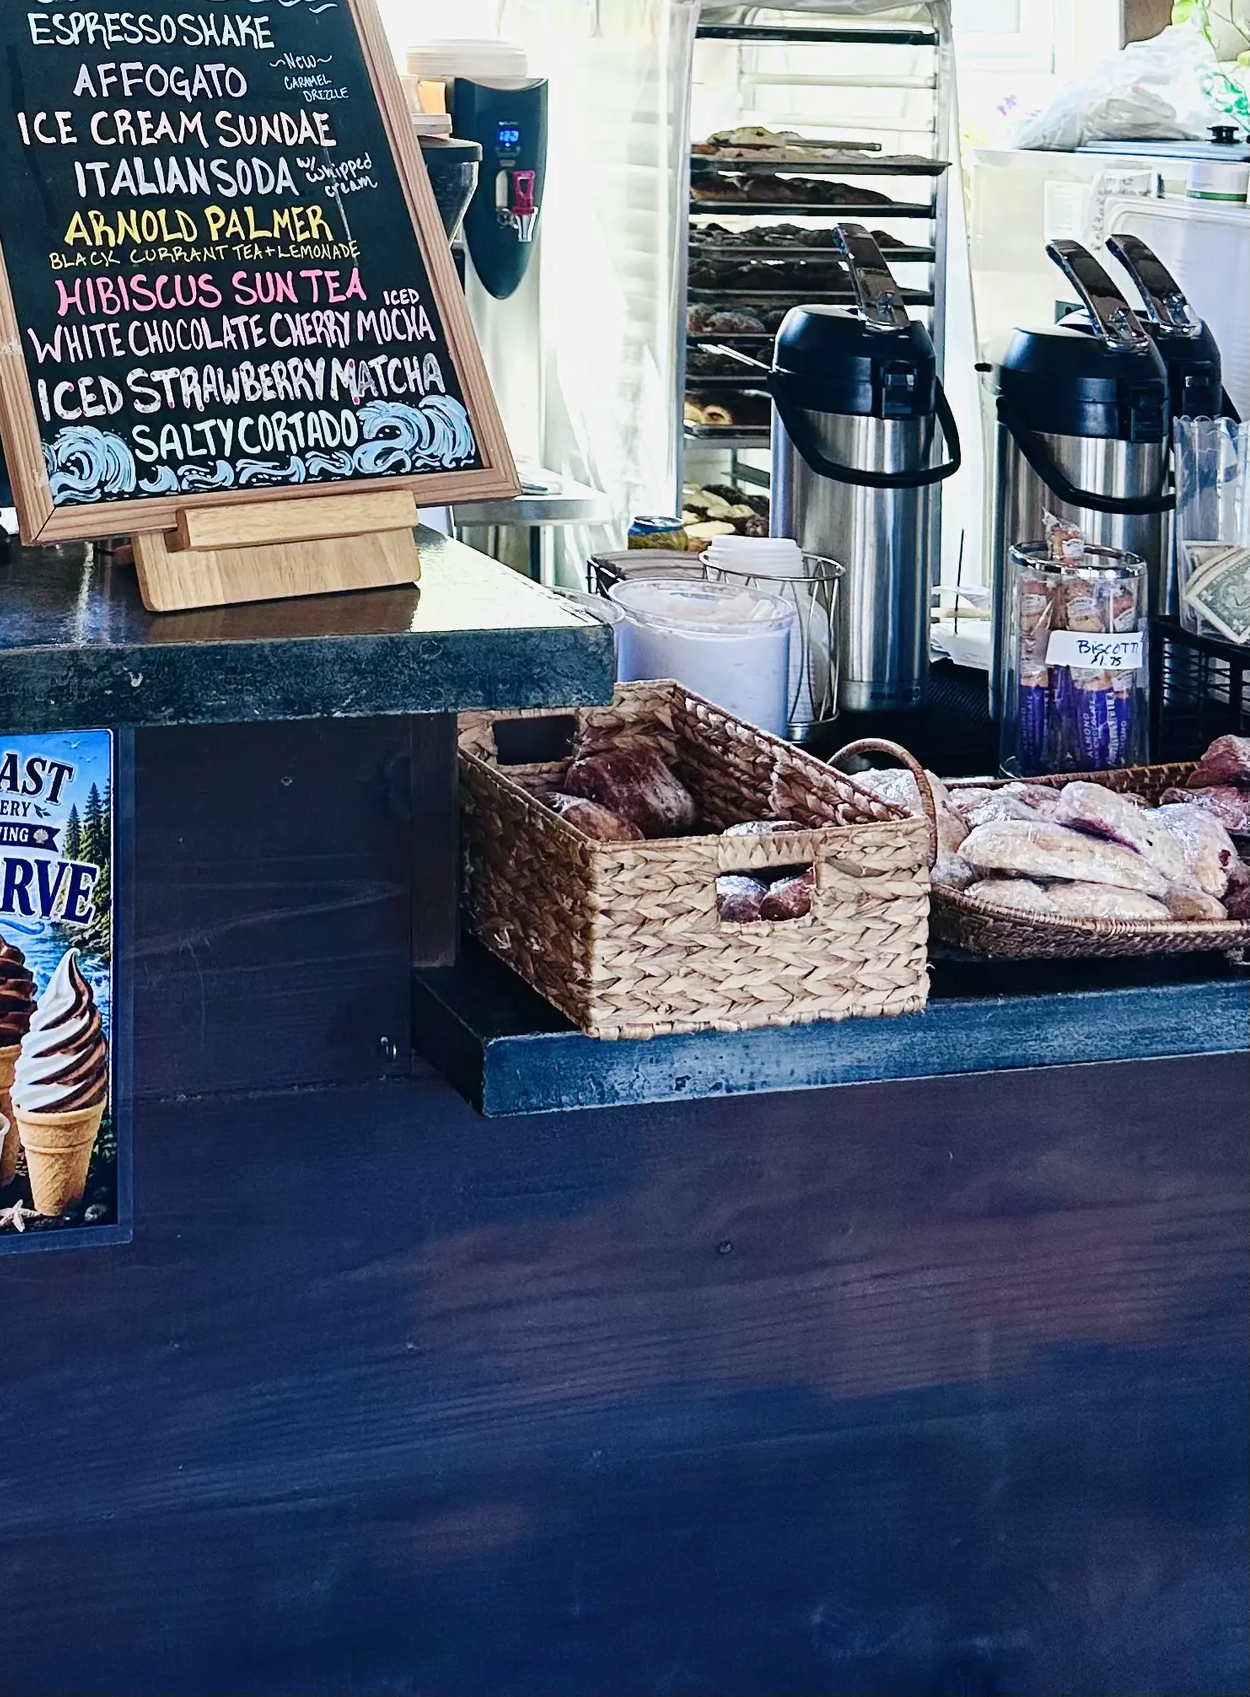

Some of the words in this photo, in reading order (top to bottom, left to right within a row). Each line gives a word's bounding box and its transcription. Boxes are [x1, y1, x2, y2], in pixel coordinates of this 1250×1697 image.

[73, 61, 248, 103] AFFOGATO
[284, 74, 333, 91] CARAMEL
[303, 86, 349, 102] DRIZZLE
[17, 110, 78, 146] ICE
[90, 110, 208, 148] CREAM
[217, 111, 337, 149] SUNDAE
[305, 152, 372, 182] whipped
[324, 175, 378, 197] cream
[63, 210, 198, 248] ARNOLD
[209, 204, 334, 243] PALMER
[49, 251, 121, 271] BLACK
[130, 245, 229, 263] CURRANT
[54, 273, 223, 317] HIBISCUS
[233, 270, 297, 305] SUN
[299, 267, 367, 303] TEA
[383, 288, 420, 306] ICED
[28, 323, 132, 364] WHITE
[128, 314, 265, 357] CHOCOLATE
[270, 310, 351, 349] CHERRY
[356, 305, 437, 343] MOCHA
[38, 377, 123, 422] ICED
[126, 356, 325, 413] STRAWBERRY
[329, 352, 446, 406] MATCHA
[131, 418, 235, 463] SALTY
[237, 408, 359, 456] CORTADO
